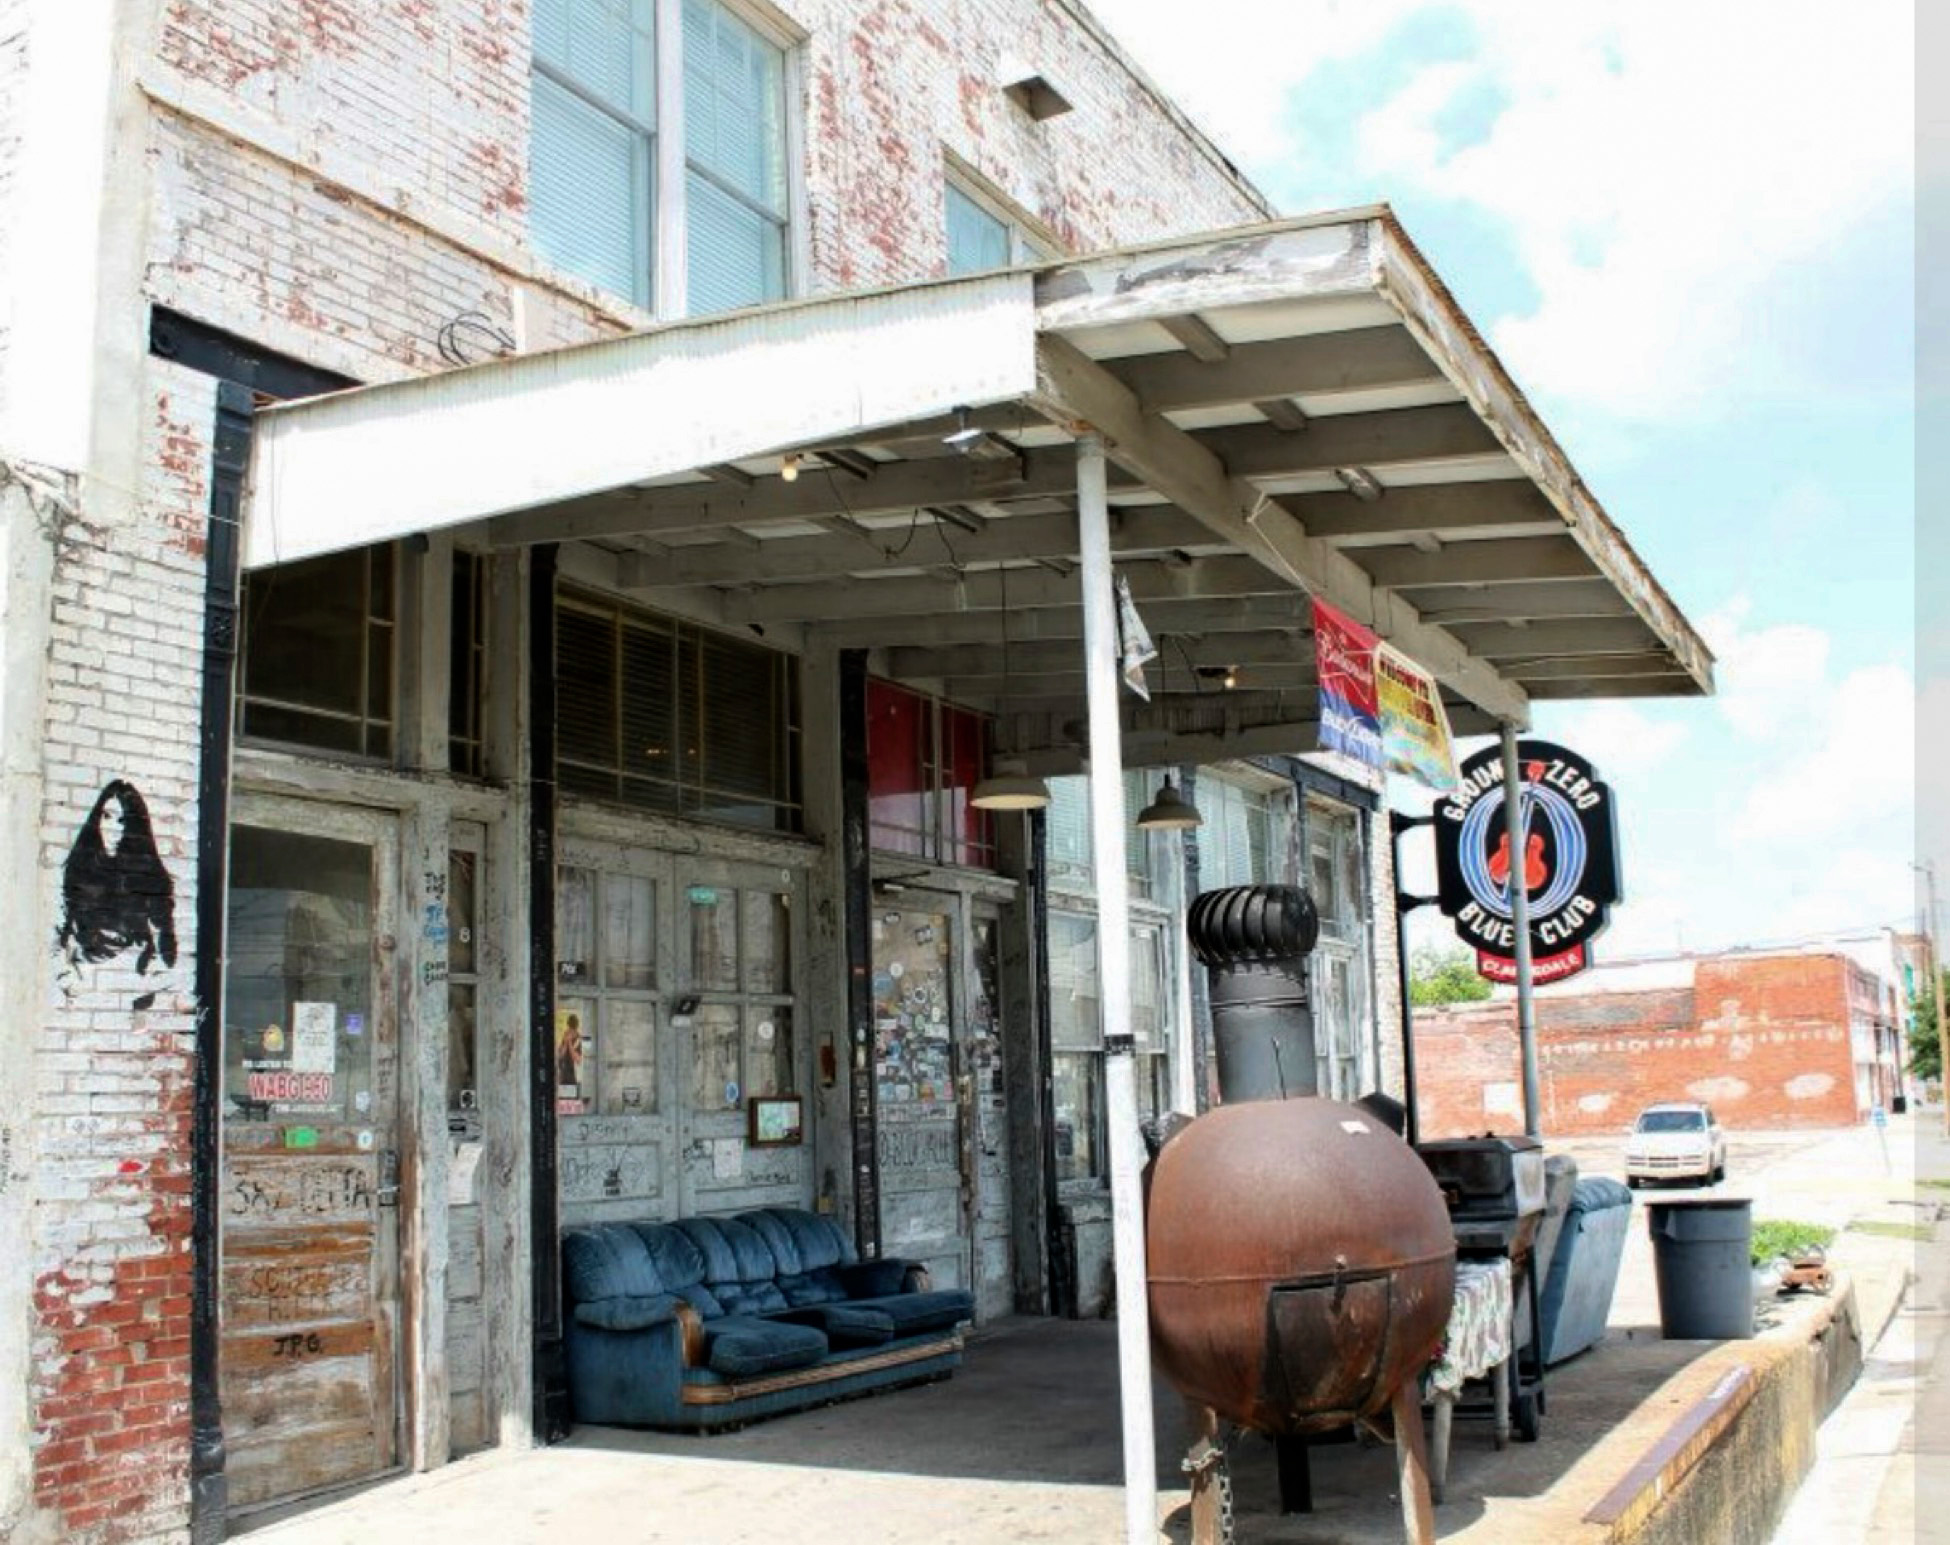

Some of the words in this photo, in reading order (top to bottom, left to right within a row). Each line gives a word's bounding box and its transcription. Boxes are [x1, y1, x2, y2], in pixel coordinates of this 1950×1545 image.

[1442, 757, 1504, 821] GROUN
[1545, 759, 1601, 810] ZERO
[1457, 902, 1515, 947] BLUE
[1540, 895, 1597, 945] CLUB
